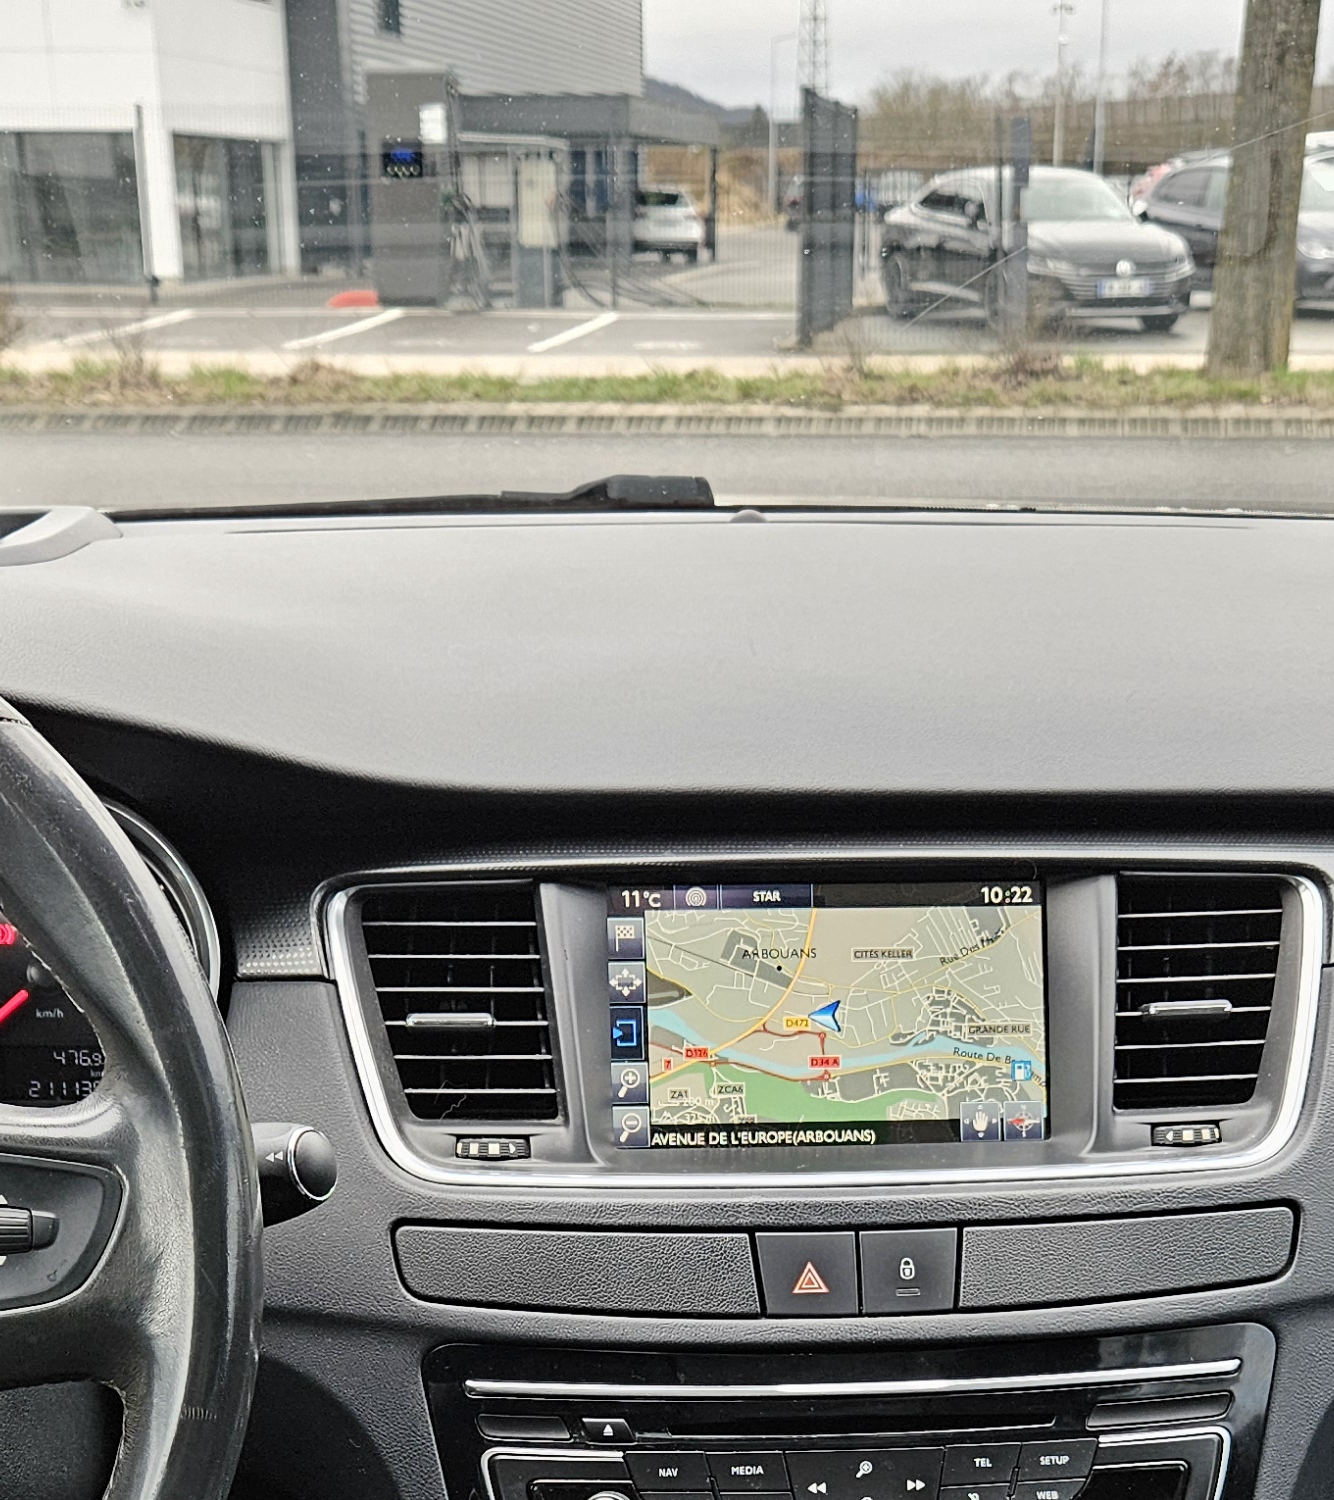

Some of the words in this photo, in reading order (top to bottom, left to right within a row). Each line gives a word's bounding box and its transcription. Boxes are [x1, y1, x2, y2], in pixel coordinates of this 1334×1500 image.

[621, 890, 662, 908] 11°C
[753, 890, 782, 902] STAR
[980, 886, 1034, 904] 10:22
[742, 948, 817, 959] ARBOUANS
[853, 948, 879, 959] CITÉS
[881, 949, 914, 959] KELLER
[35, 1008, 64, 1019] km/h
[968, 1025, 1009, 1034] GRANDE
[1011, 1024, 1031, 1034] RUE
[953, 1046, 984, 1060] Route
[986, 1052, 1001, 1062] De
[651, 1132, 706, 1146] AVENUE
[709, 1131, 728, 1145] DE
[974, 1457, 992, 1468] TEL
[1039, 1455, 1070, 1466] SETUP
[658, 1467, 678, 1478] NAV
[731, 1465, 764, 1476] MEDIA
[1036, 1490, 1059, 1500] WEB
